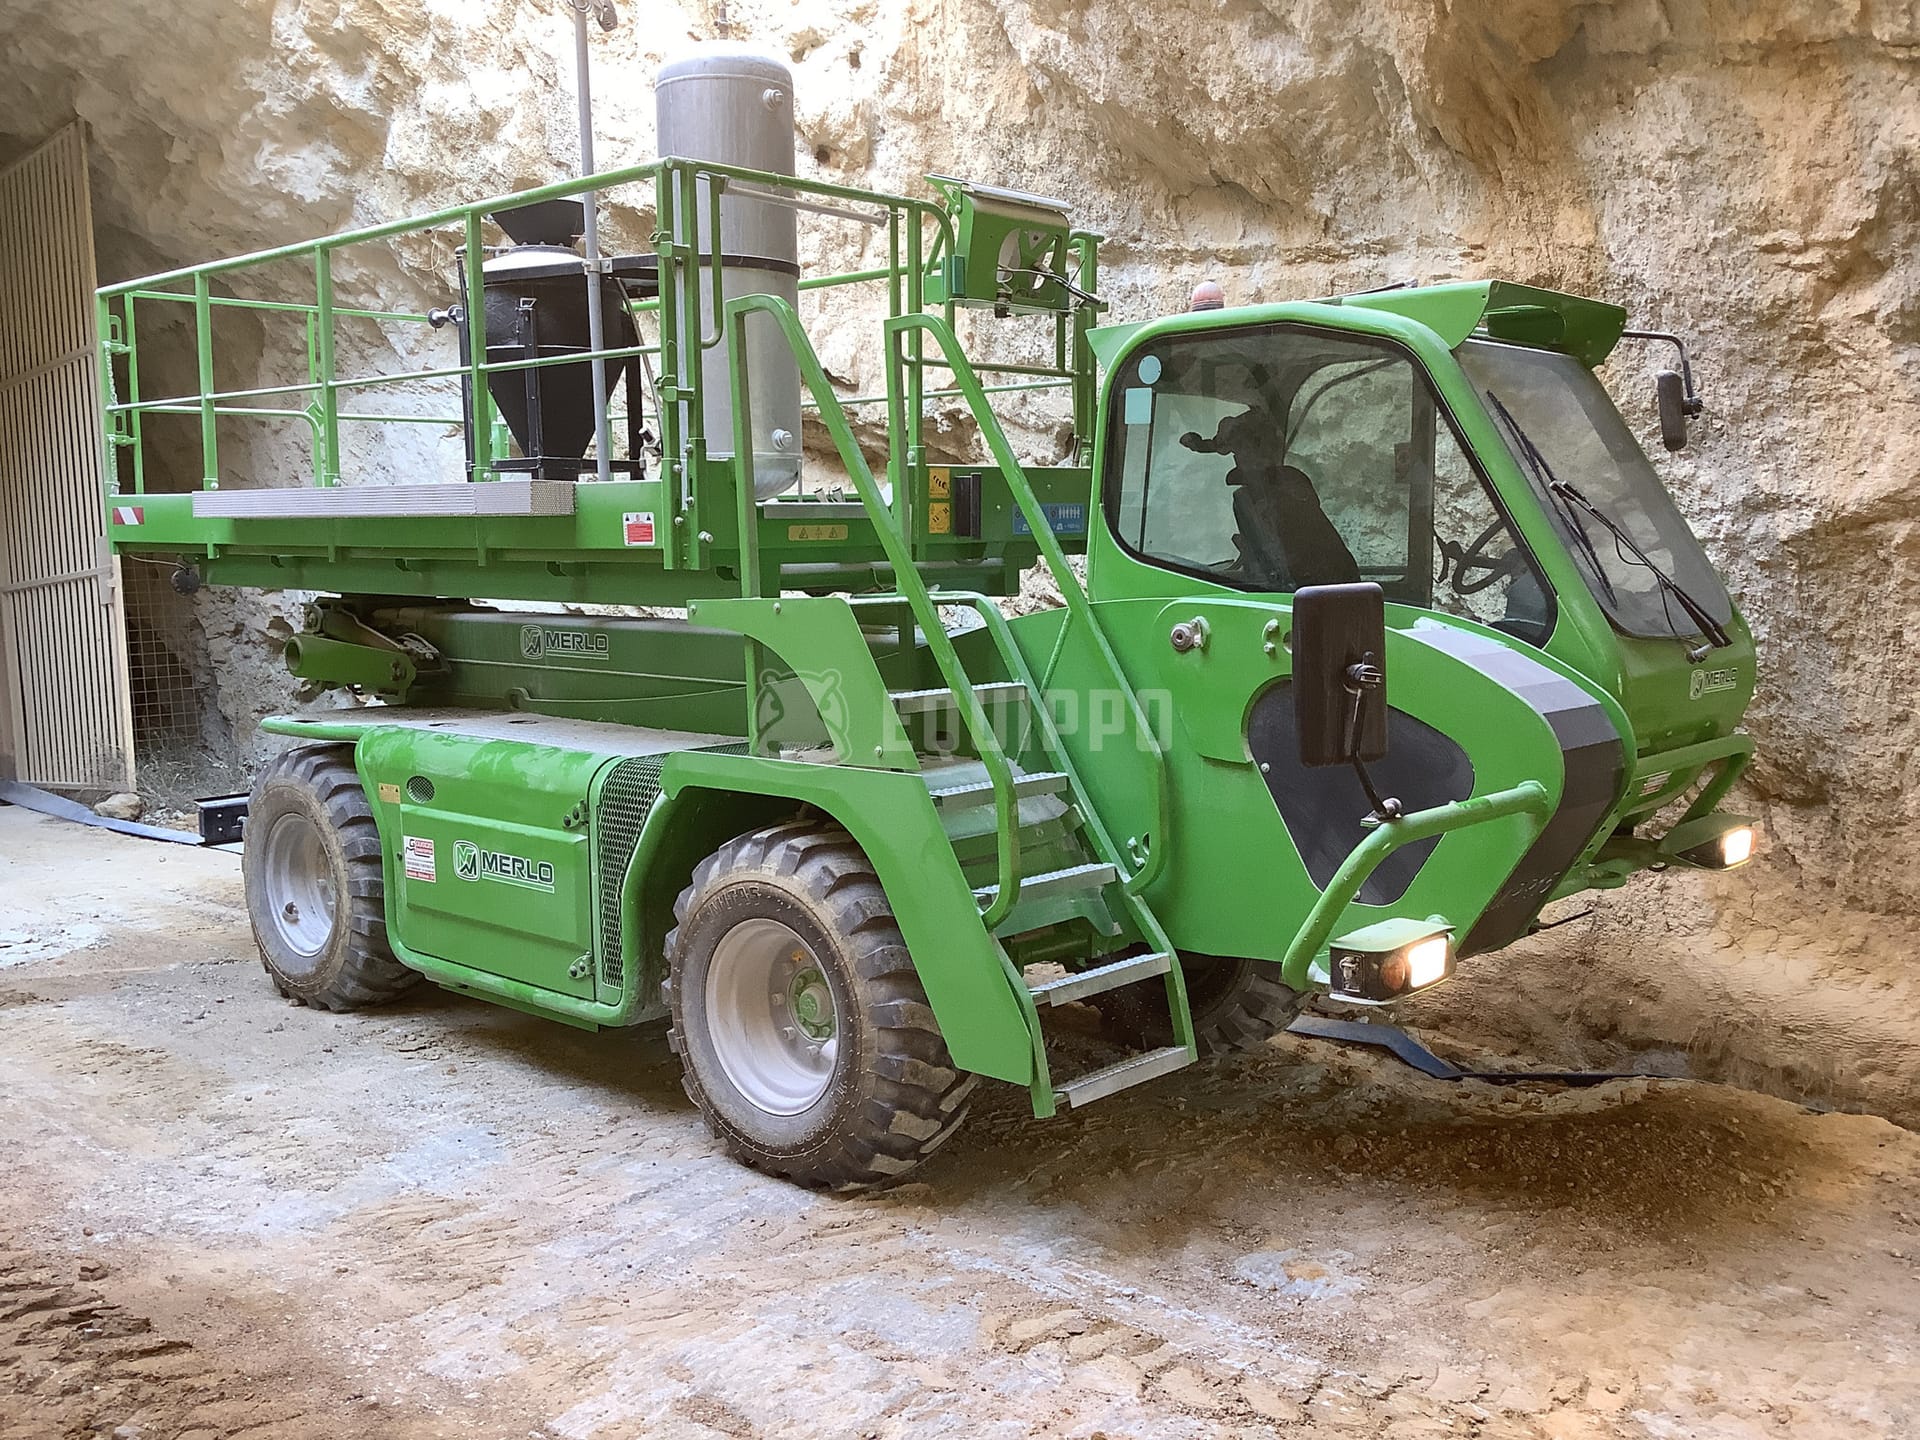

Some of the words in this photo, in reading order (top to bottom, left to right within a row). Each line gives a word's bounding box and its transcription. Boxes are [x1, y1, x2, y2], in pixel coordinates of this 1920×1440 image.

[545, 631, 609, 652] MERLO
[1704, 667, 1738, 687] MERLO
[481, 850, 555, 884] MERLO
